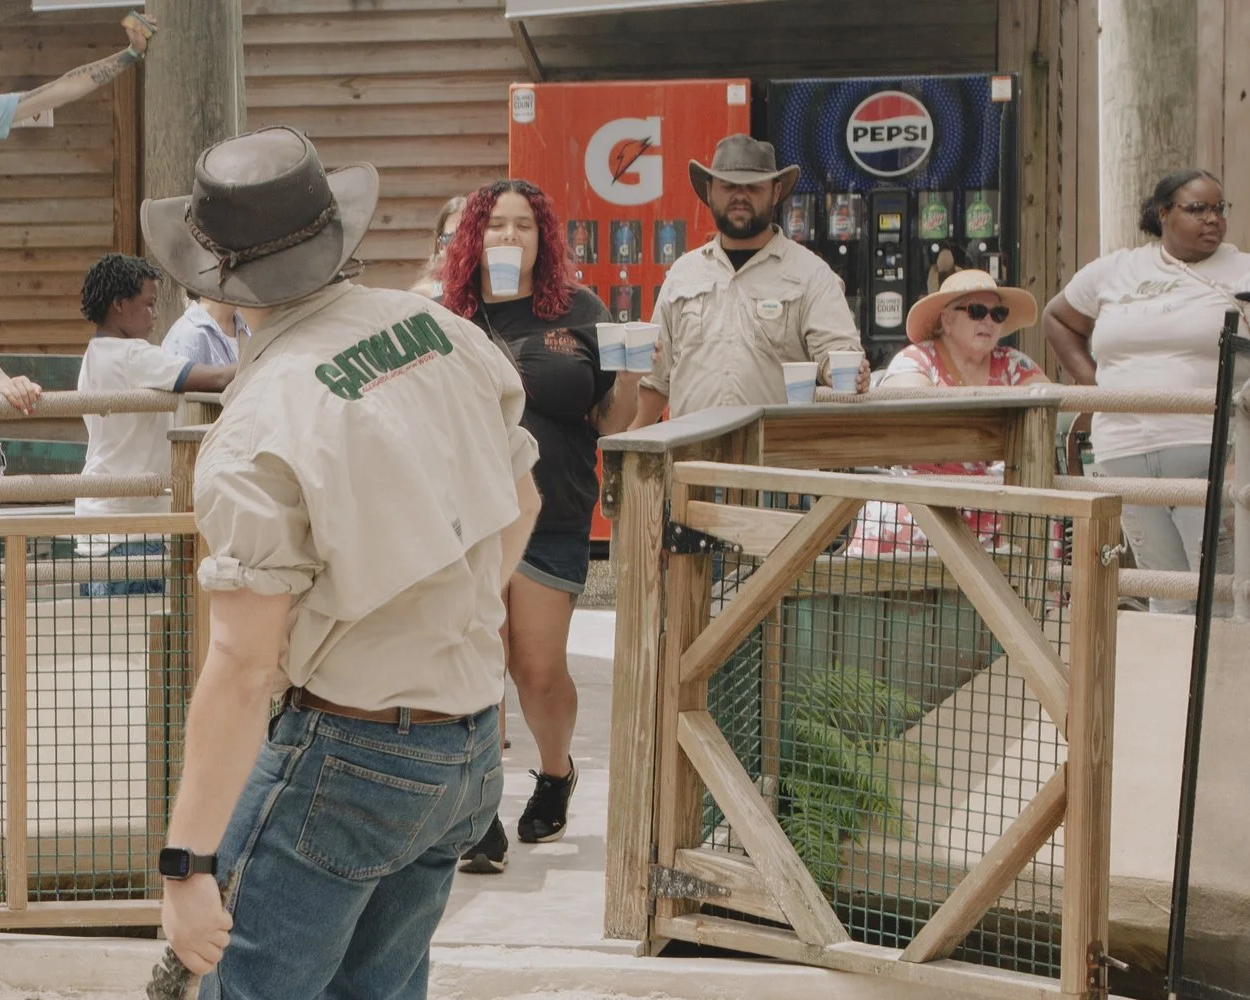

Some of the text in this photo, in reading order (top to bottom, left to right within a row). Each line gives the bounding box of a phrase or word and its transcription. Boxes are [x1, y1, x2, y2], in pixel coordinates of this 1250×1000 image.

[585, 116, 664, 205] G
[853, 125, 927, 142] PEPSI
[314, 312, 453, 401] GATORLAND
